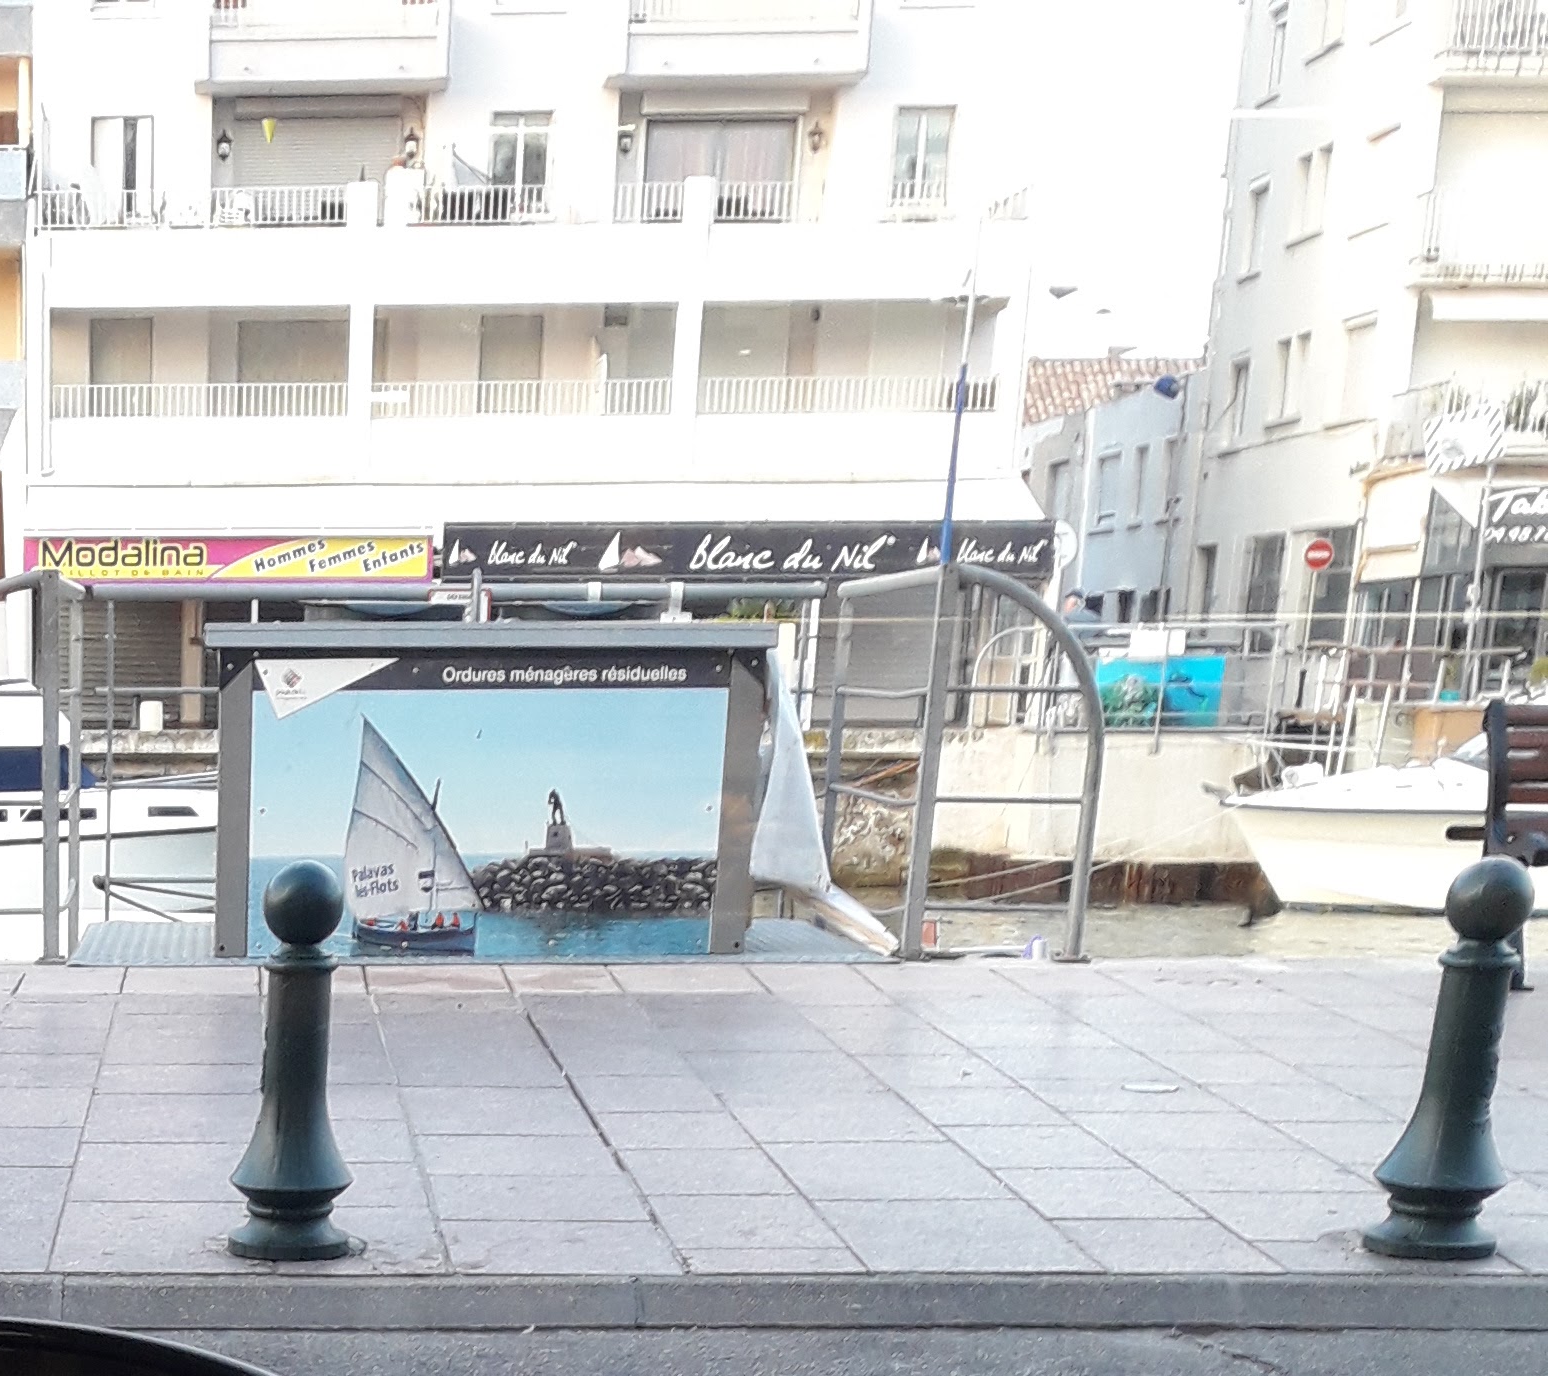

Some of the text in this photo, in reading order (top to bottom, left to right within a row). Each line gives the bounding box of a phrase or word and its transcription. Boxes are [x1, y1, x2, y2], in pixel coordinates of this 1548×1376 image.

[41, 537, 205, 568] Modalina
[254, 538, 327, 573] Hommes
[308, 540, 376, 573] Femmes
[362, 542, 425, 573] Enfants
[528, 541, 550, 566] du
[782, 537, 823, 571] du
[997, 540, 1015, 562] du
[442, 663, 688, 686] Ordures ménagères résiduelles
[351, 863, 395, 882] Palavas
